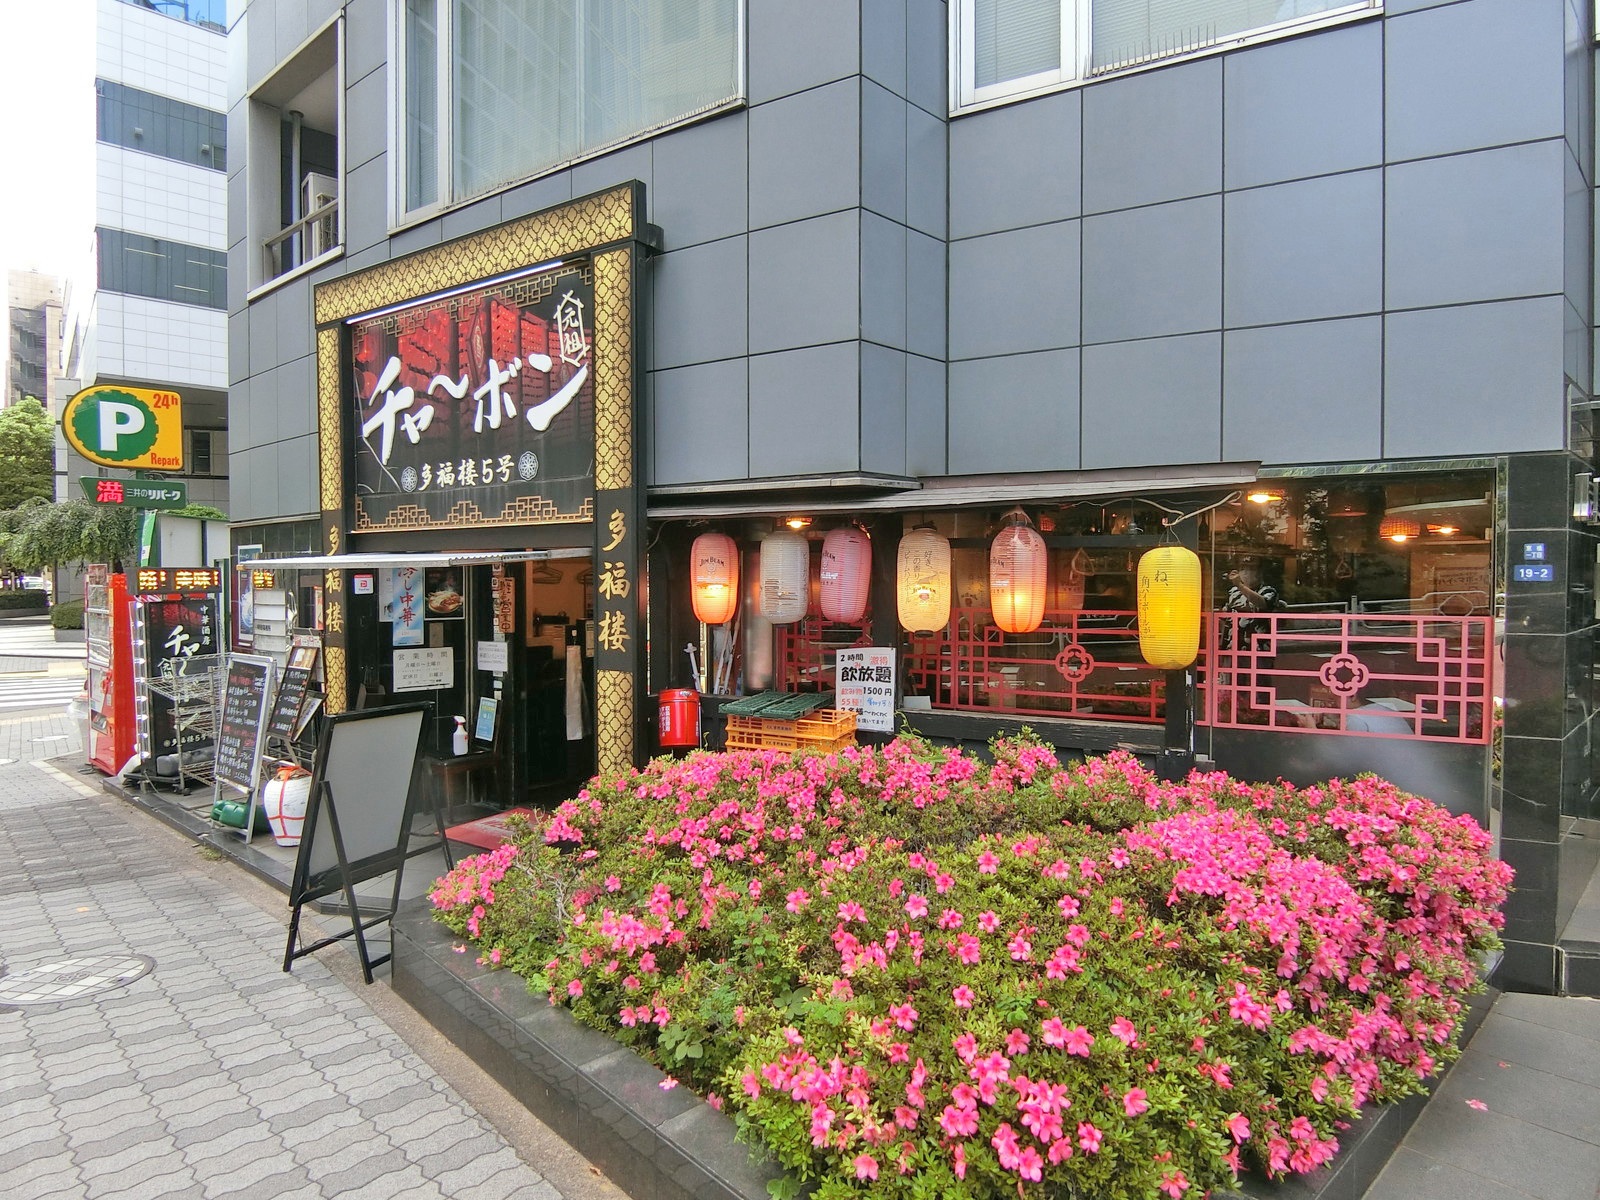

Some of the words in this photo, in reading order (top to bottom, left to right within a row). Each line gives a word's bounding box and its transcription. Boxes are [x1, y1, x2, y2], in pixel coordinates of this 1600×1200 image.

[561, 306, 584, 355] 元祖
[153, 393, 179, 410] 24h
[98, 400, 146, 452] P
[150, 453, 180, 467] Repark
[418, 454, 515, 491] 多福楼5号
[96, 480, 124, 504] 満
[126, 488, 181, 501] 三井のリパーク
[325, 524, 345, 634] 多福楼
[597, 508, 632, 653] 多福楼
[1519, 568, 1549, 578] 19-2
[841, 666, 892, 684] 飲放題
[863, 686, 892, 697] 1500円
